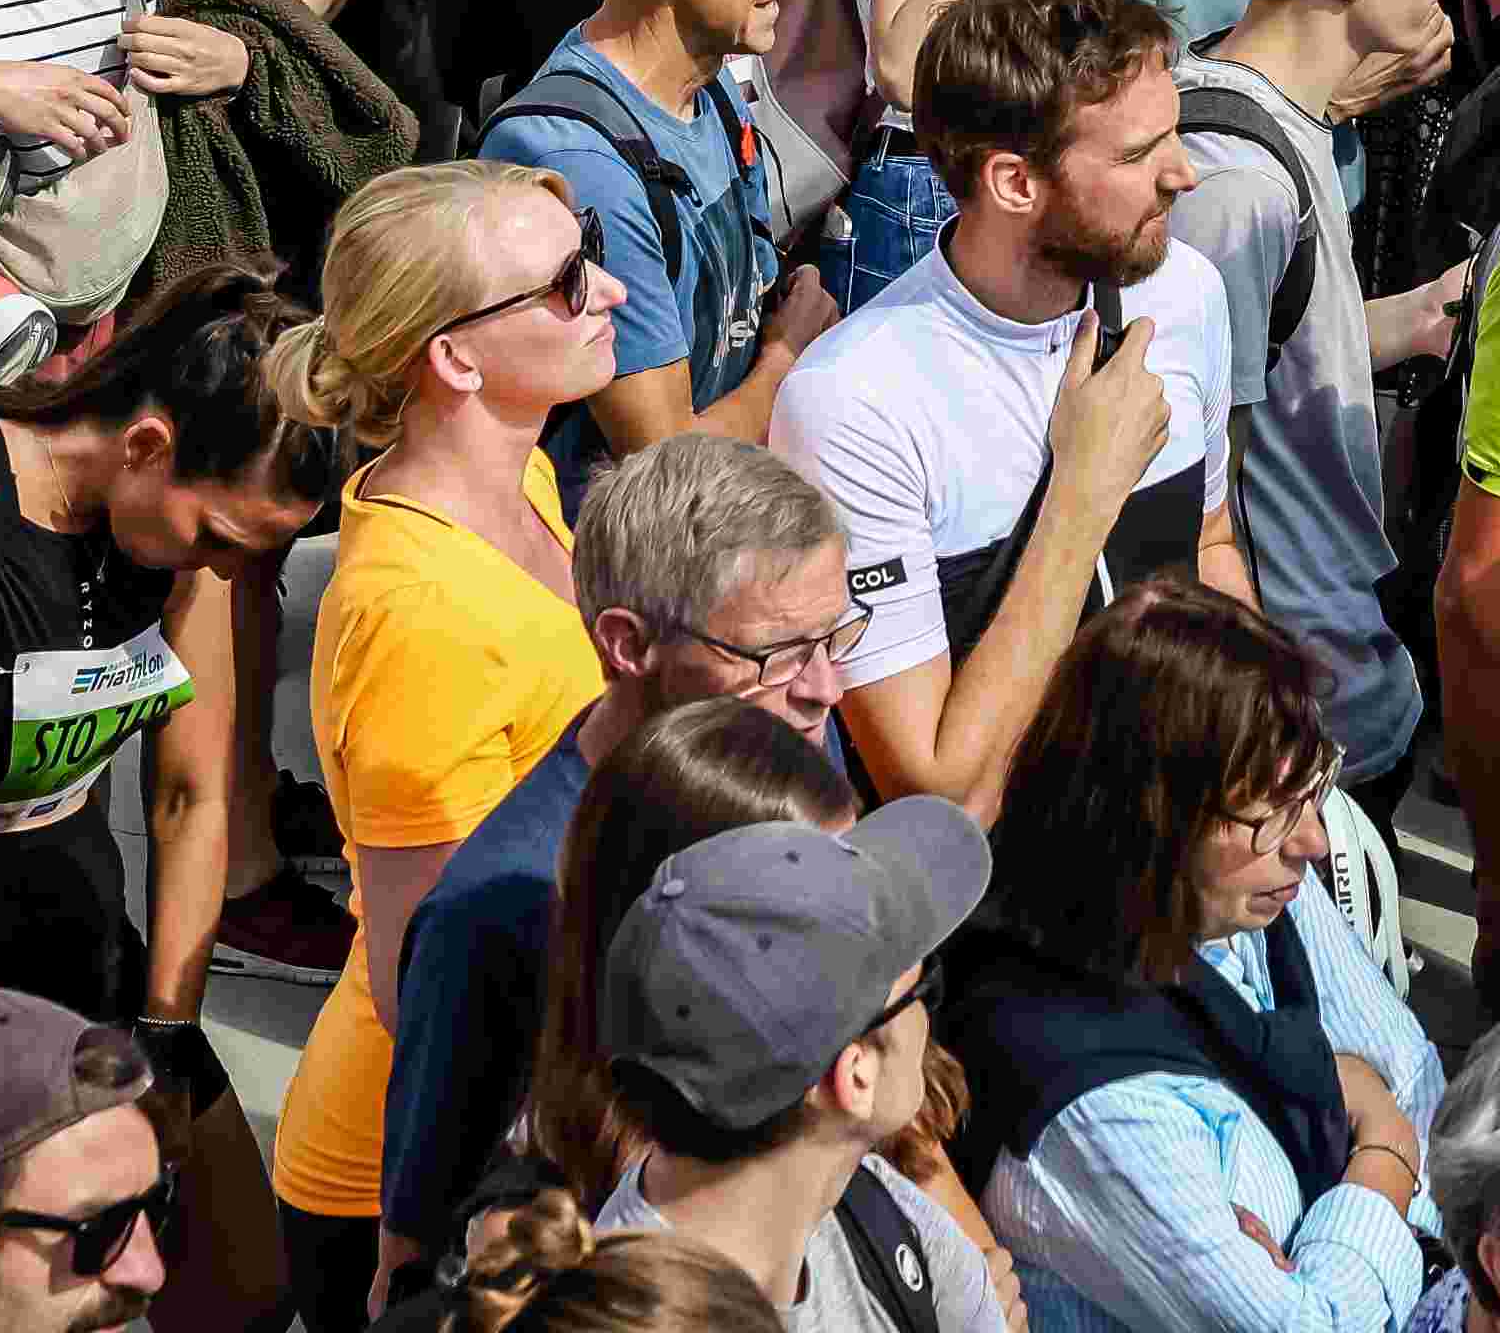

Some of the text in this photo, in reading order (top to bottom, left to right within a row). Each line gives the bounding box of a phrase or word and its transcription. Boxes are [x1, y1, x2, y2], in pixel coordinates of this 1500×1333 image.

[851, 566, 896, 590] COL
[90, 652, 165, 693] Triathlon
[27, 713, 98, 774] STO
